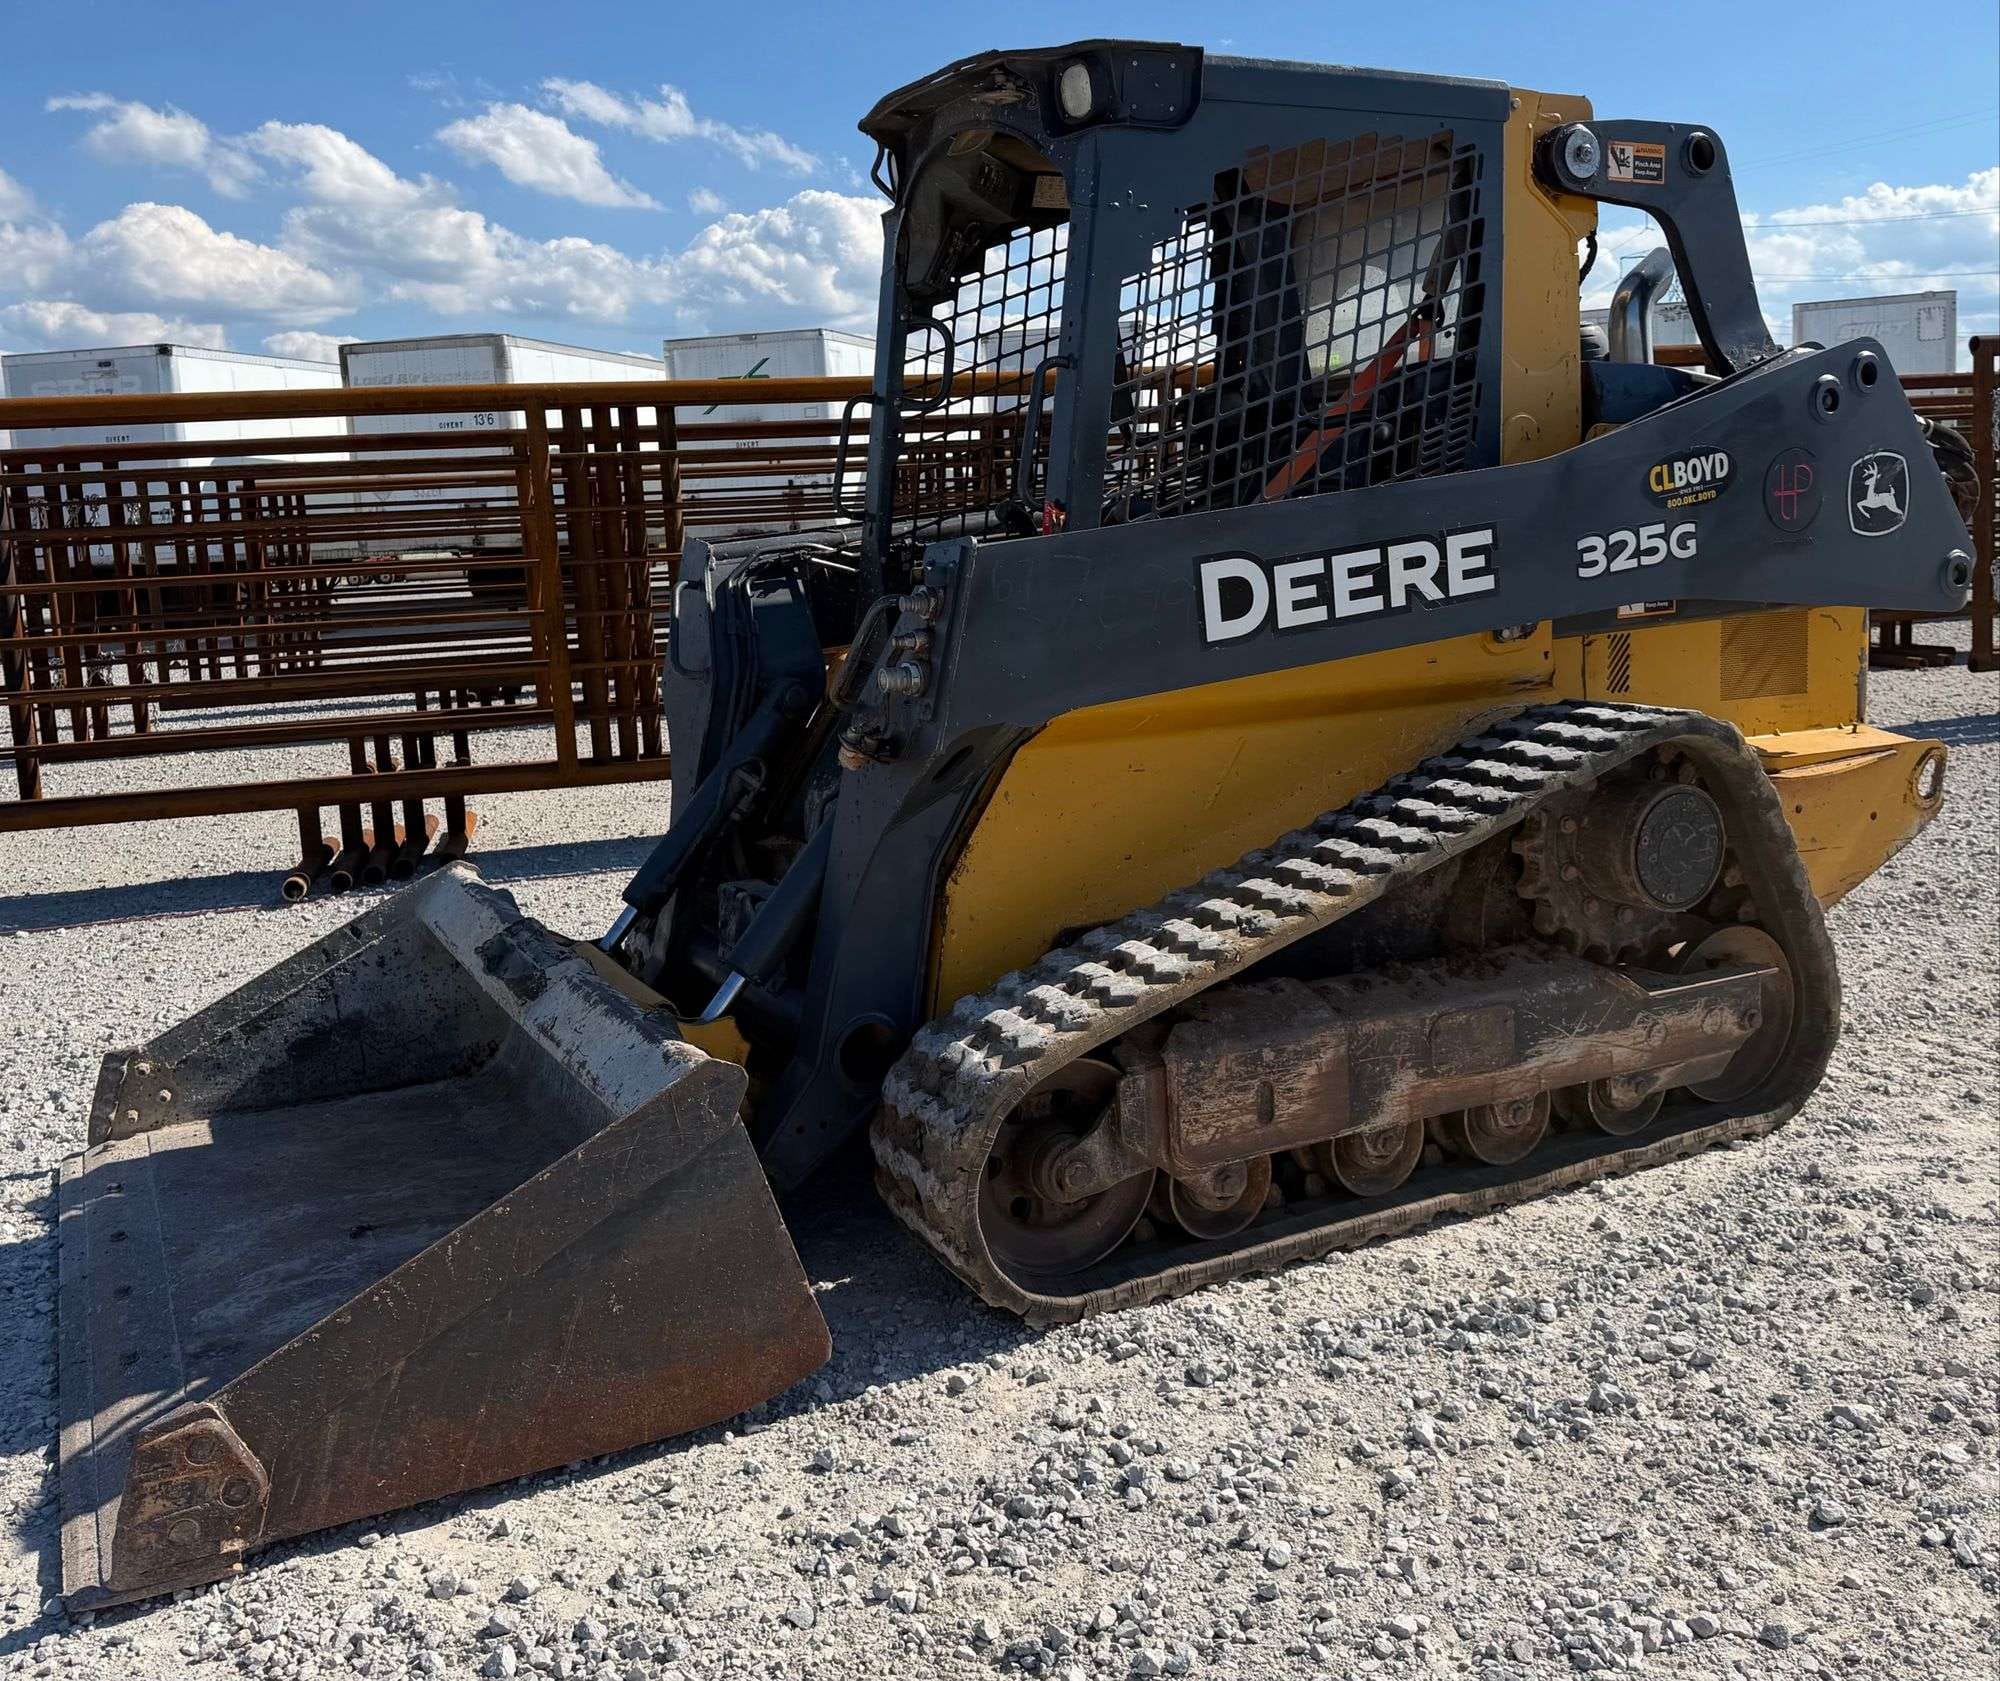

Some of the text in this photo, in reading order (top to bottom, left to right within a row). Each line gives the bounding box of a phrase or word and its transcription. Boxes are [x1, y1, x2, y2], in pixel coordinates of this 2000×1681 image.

[473, 413, 496, 426] 13'6
[1577, 523, 1697, 578] 325G
[1200, 529, 1496, 642] DEERE
